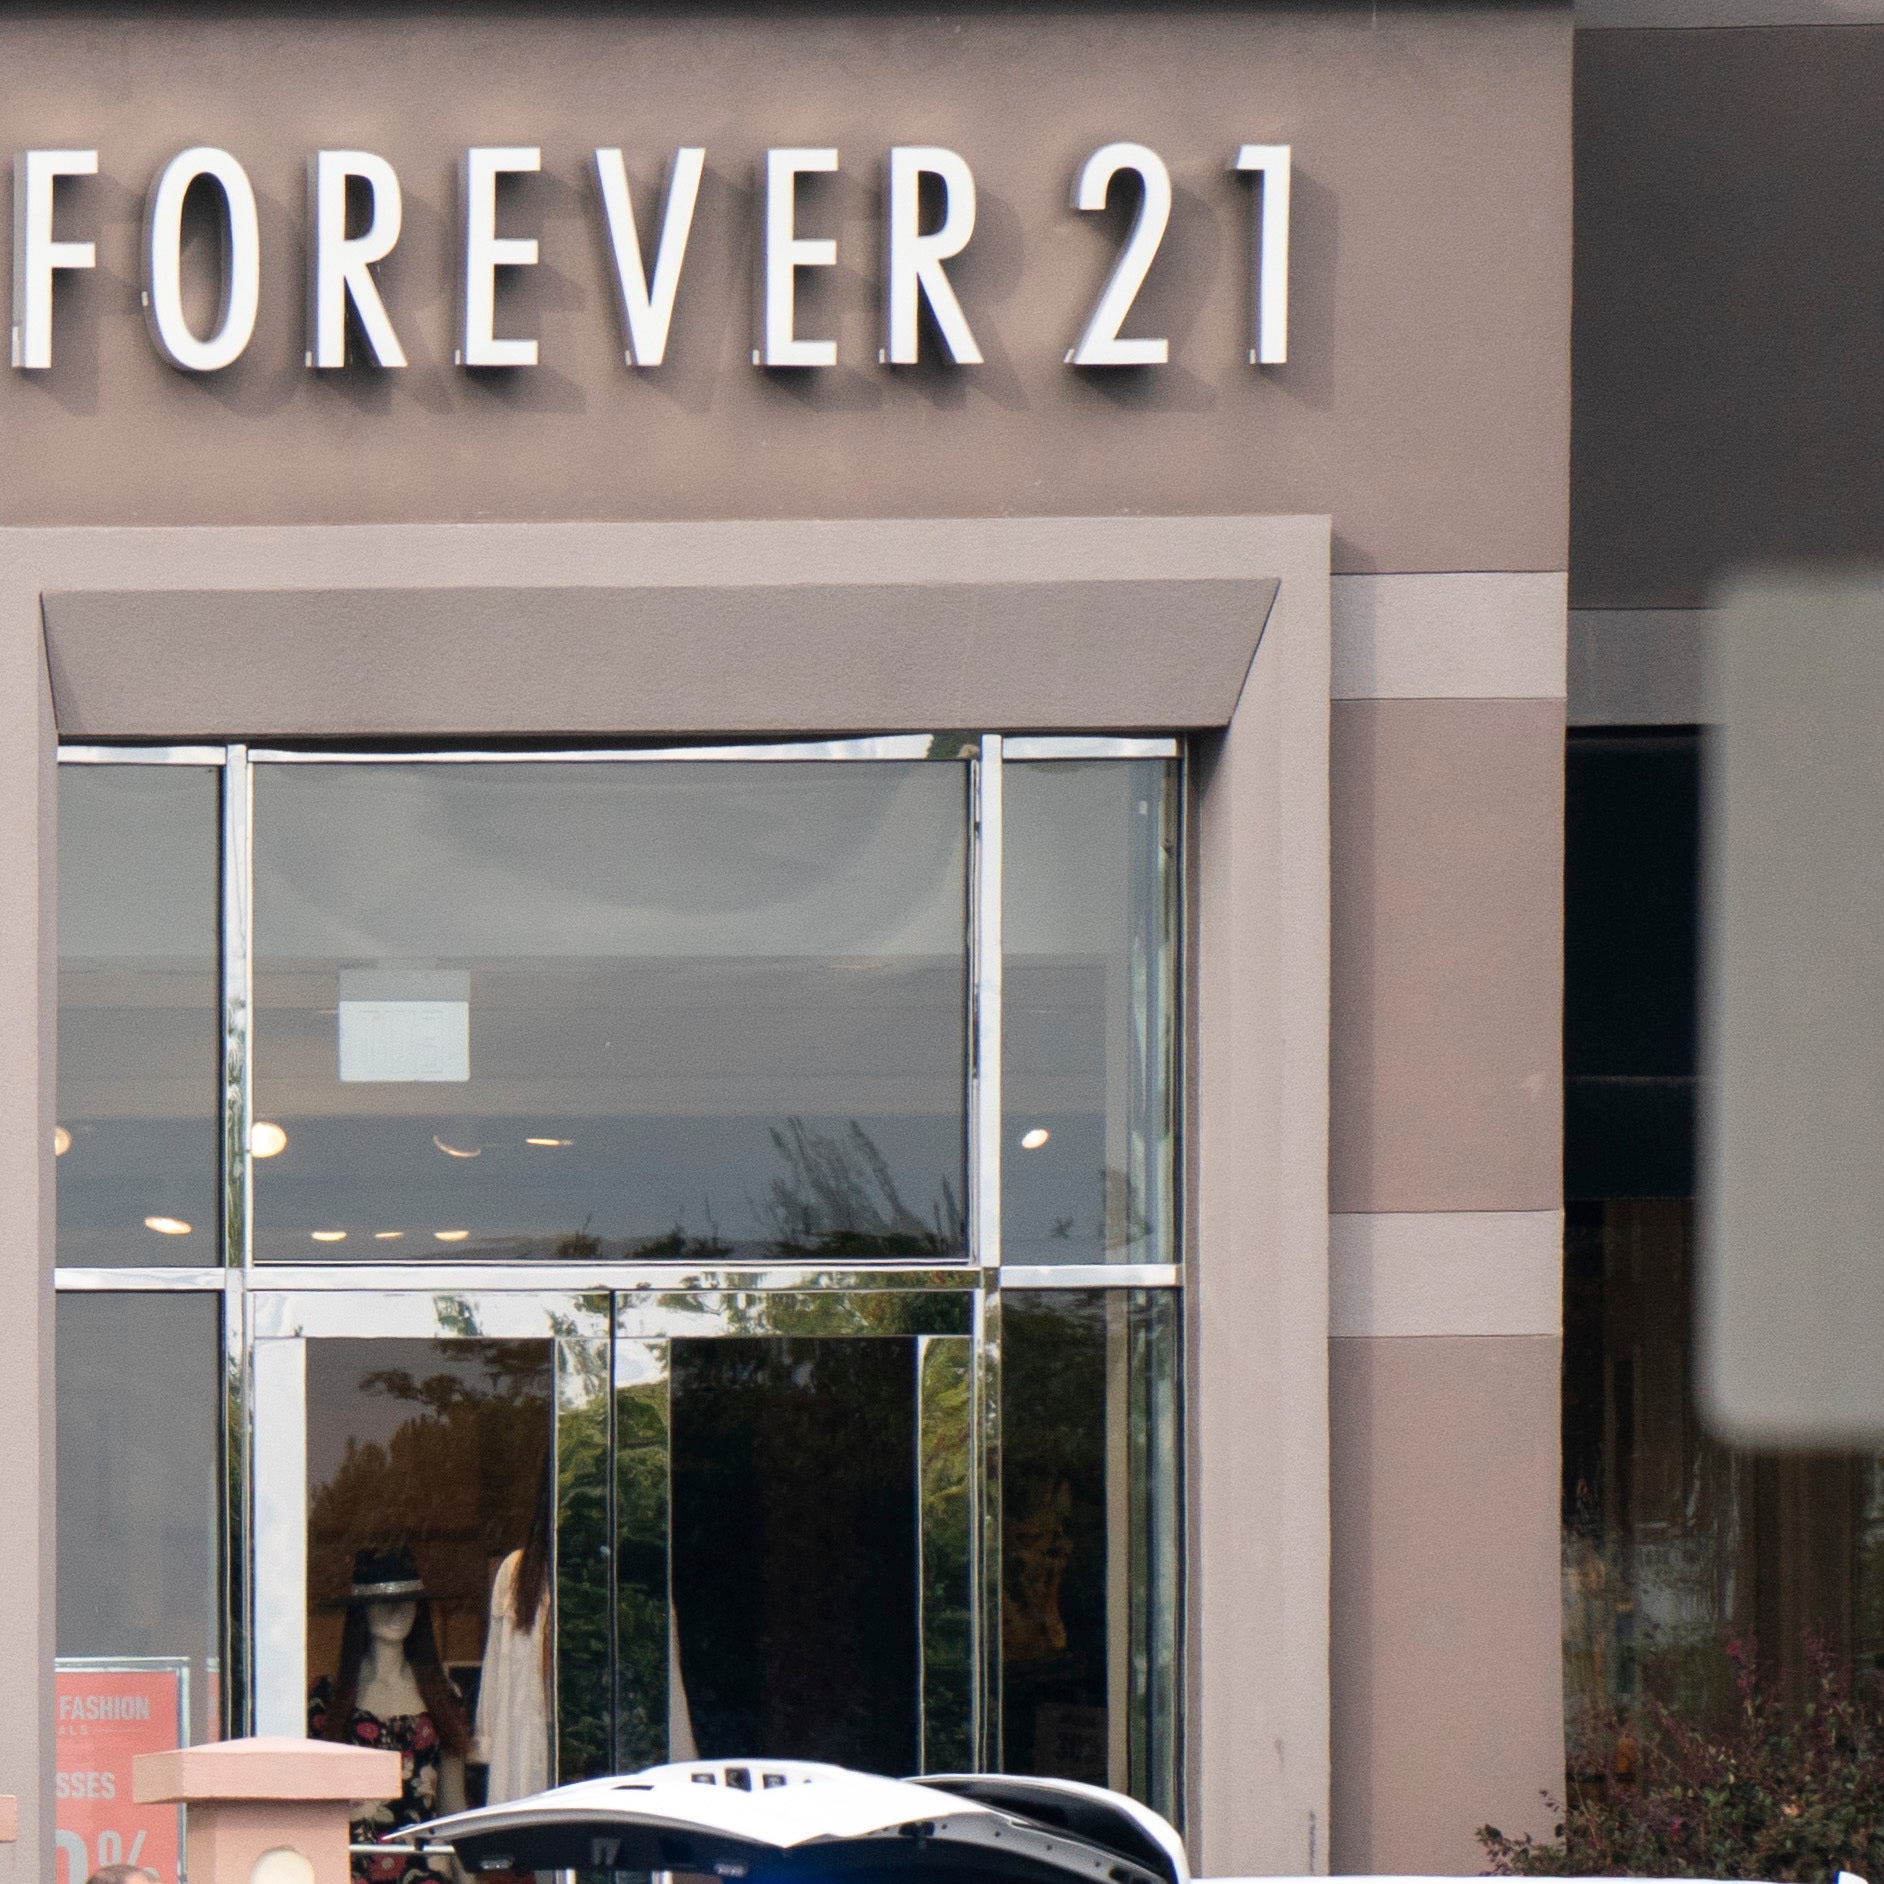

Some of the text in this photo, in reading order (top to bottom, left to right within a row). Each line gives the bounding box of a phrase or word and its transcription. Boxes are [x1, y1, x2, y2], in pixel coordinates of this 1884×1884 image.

[12, 142, 1291, 371] FOREVER 21
[59, 1695, 151, 1721] FASHION
